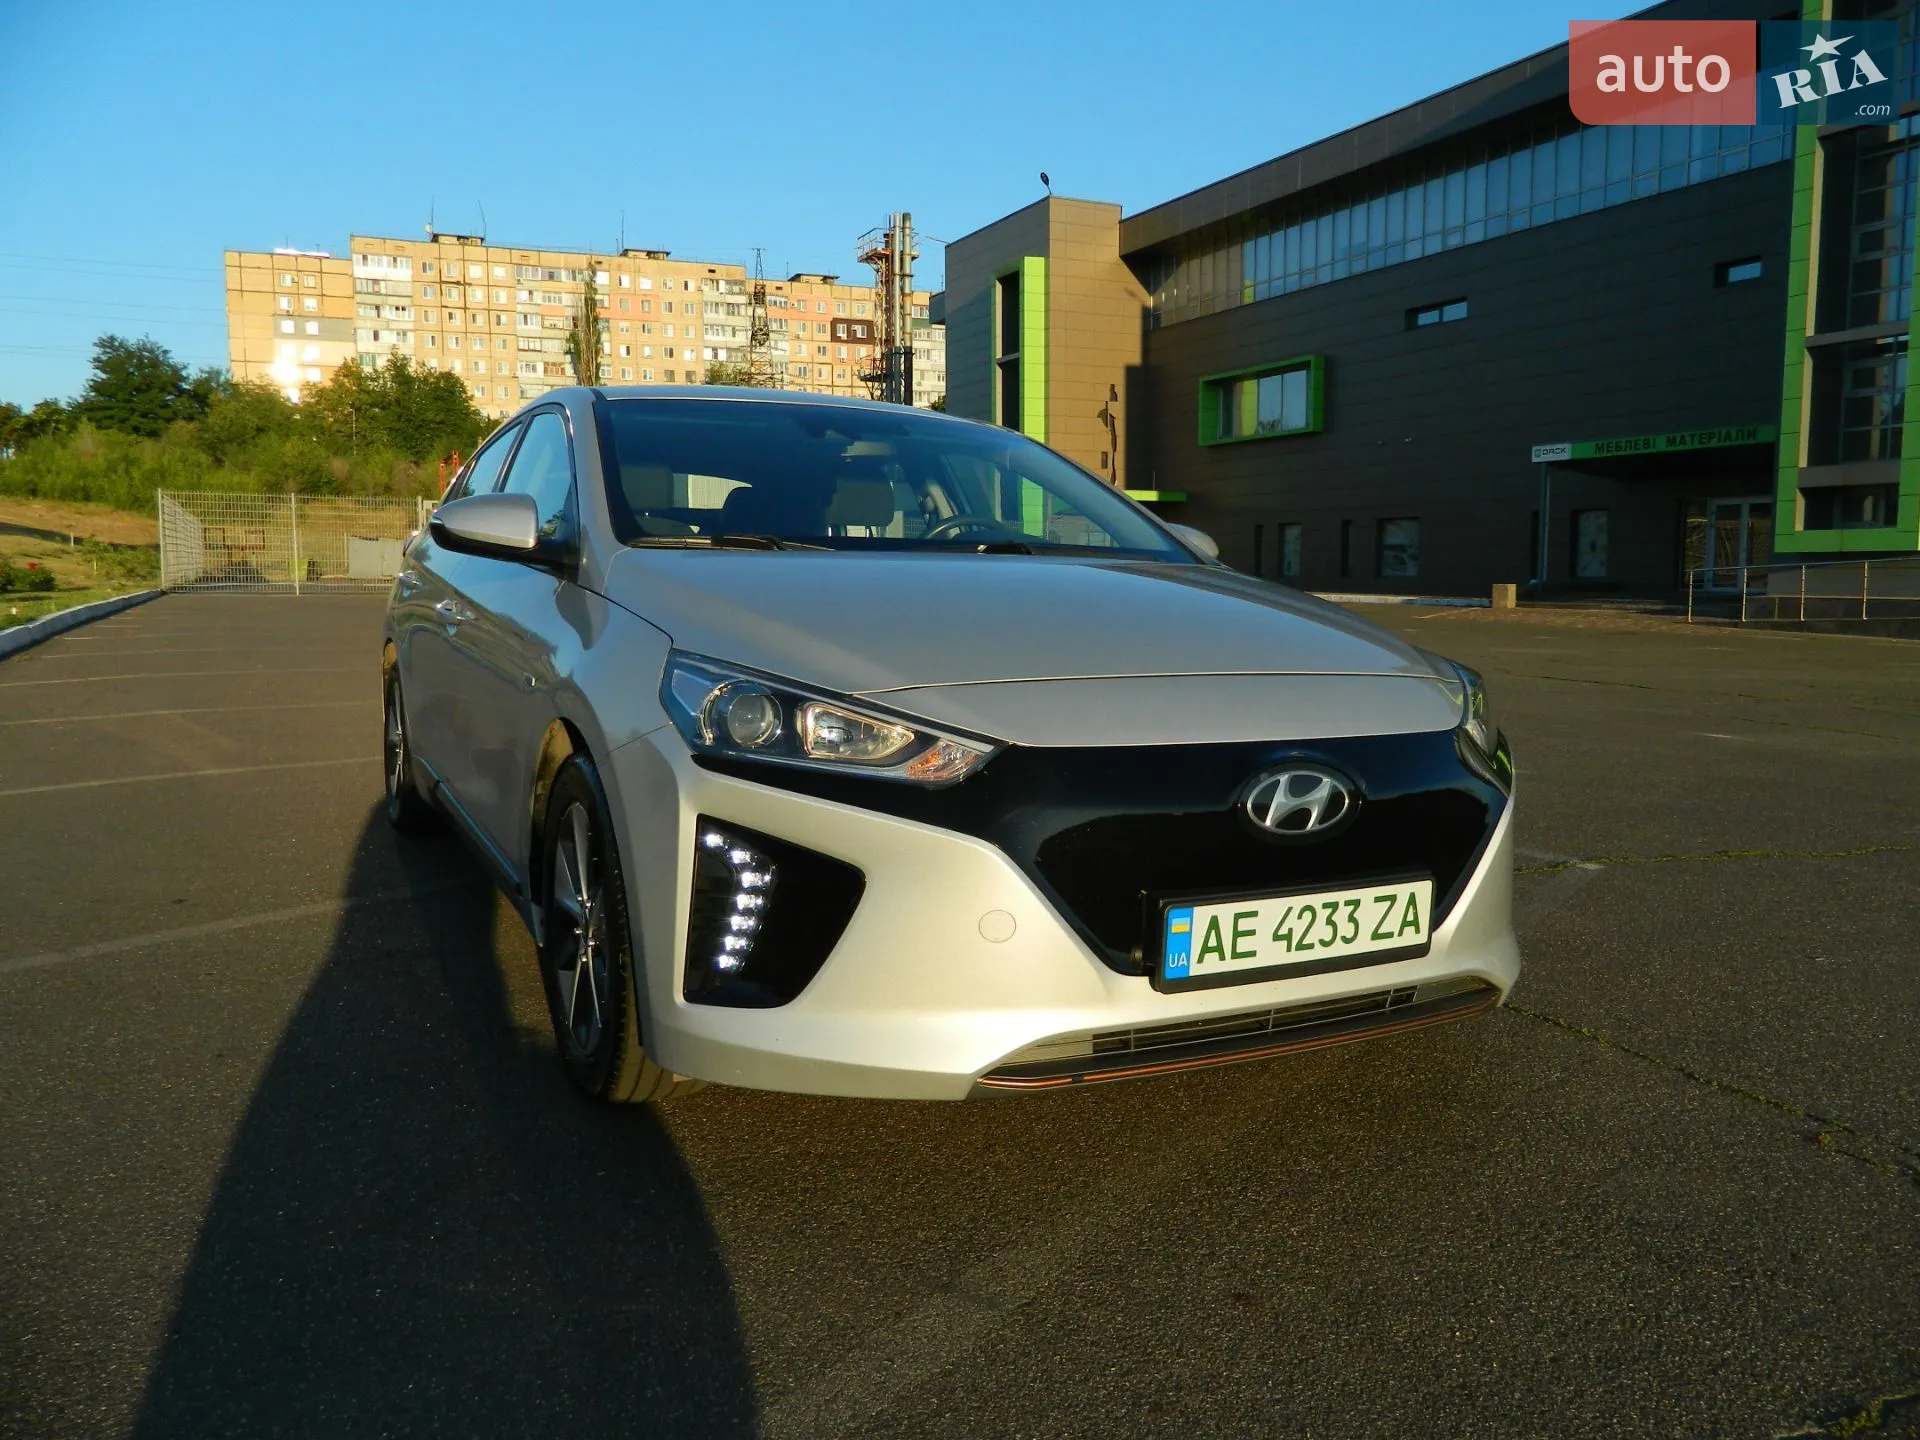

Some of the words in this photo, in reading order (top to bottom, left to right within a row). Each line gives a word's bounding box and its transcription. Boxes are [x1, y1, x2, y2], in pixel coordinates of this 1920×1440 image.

[1594, 437, 1656, 455] МЕБЛЕВІ
[1665, 427, 1758, 449] МАТЕРІАЛИ
[1196, 910, 1259, 964] AE
[1272, 898, 1361, 953] 4233
[1370, 891, 1421, 941] ZA
[1168, 953, 1188, 968] UA
